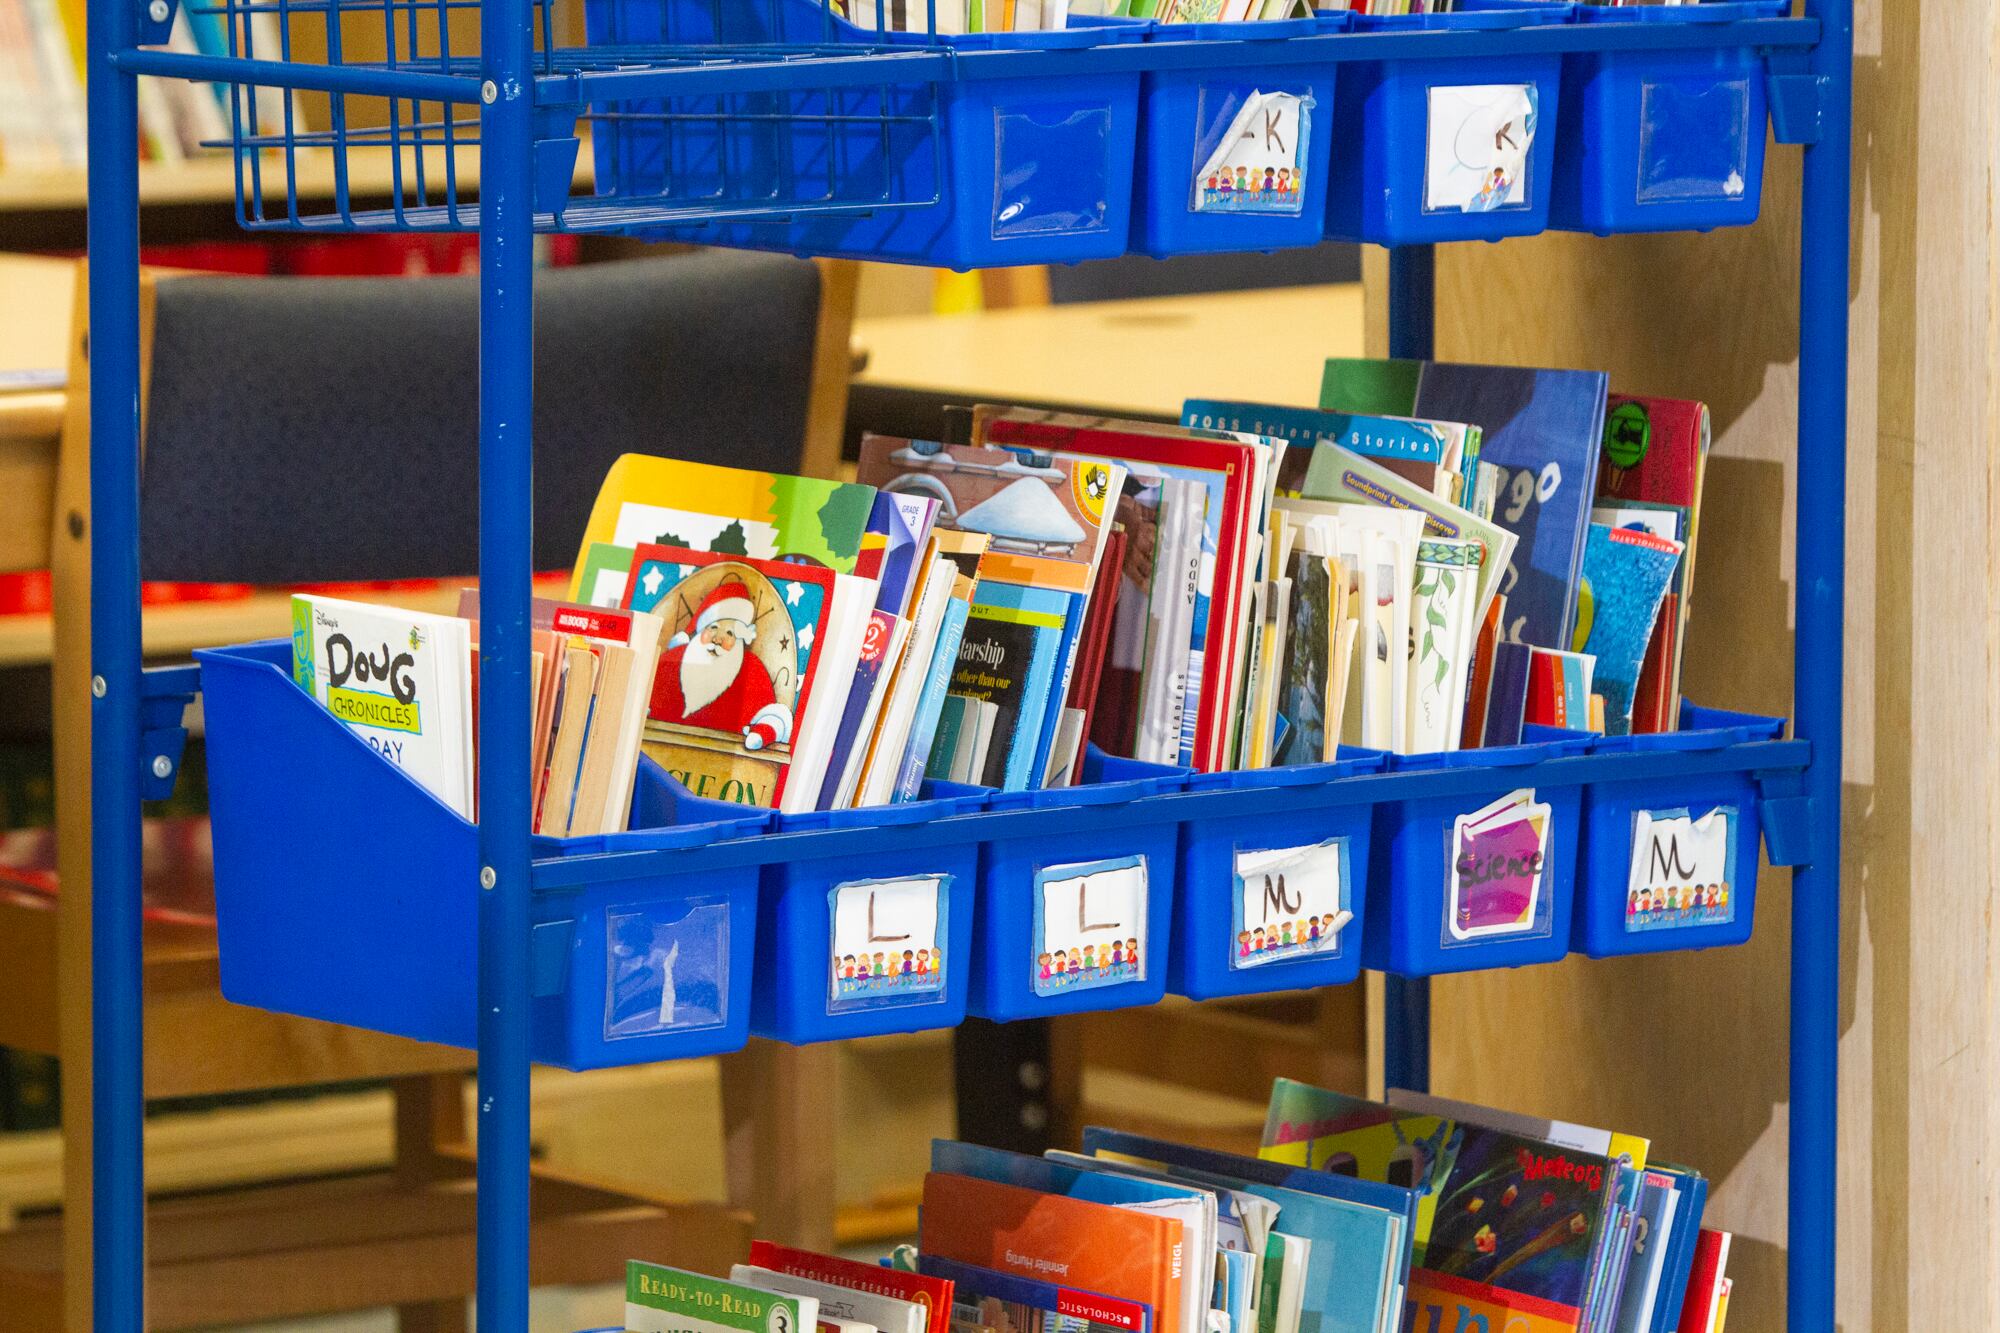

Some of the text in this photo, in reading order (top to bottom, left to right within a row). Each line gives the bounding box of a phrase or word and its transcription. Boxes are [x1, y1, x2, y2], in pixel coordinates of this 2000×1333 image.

[1189, 414, 1431, 454] FOSS Science Stories
[902, 505, 920, 515] GRADE
[910, 516, 916, 526] 3
[1425, 514, 1456, 537] Discover
[1612, 532, 1668, 552] SCHOLASTIC
[1187, 558, 1198, 605] ABDO
[863, 626, 879, 650] 2
[958, 637, 1005, 670] tarship
[978, 672, 996, 688] than
[996, 678, 1011, 689] our
[334, 697, 412, 726] CHRONICLES
[1171, 674, 1185, 740] LEADERS
[370, 736, 403, 764] DAY
[906, 755, 924, 791] Journey
[1455, 848, 1545, 889] Science
[1649, 833, 1698, 885] M
[1080, 882, 1121, 933] L
[1262, 873, 1303, 924] M
[868, 891, 911, 942] L
[1524, 1153, 1603, 1192] Meteors
[1038, 1260, 1069, 1277] Jennifer
[1172, 1241, 1183, 1279] WEIGL
[785, 1264, 906, 1300] SCHOLASTIC READER
[775, 1316, 788, 1333] 3
[1060, 1301, 1122, 1324] SCHOLASTIC
